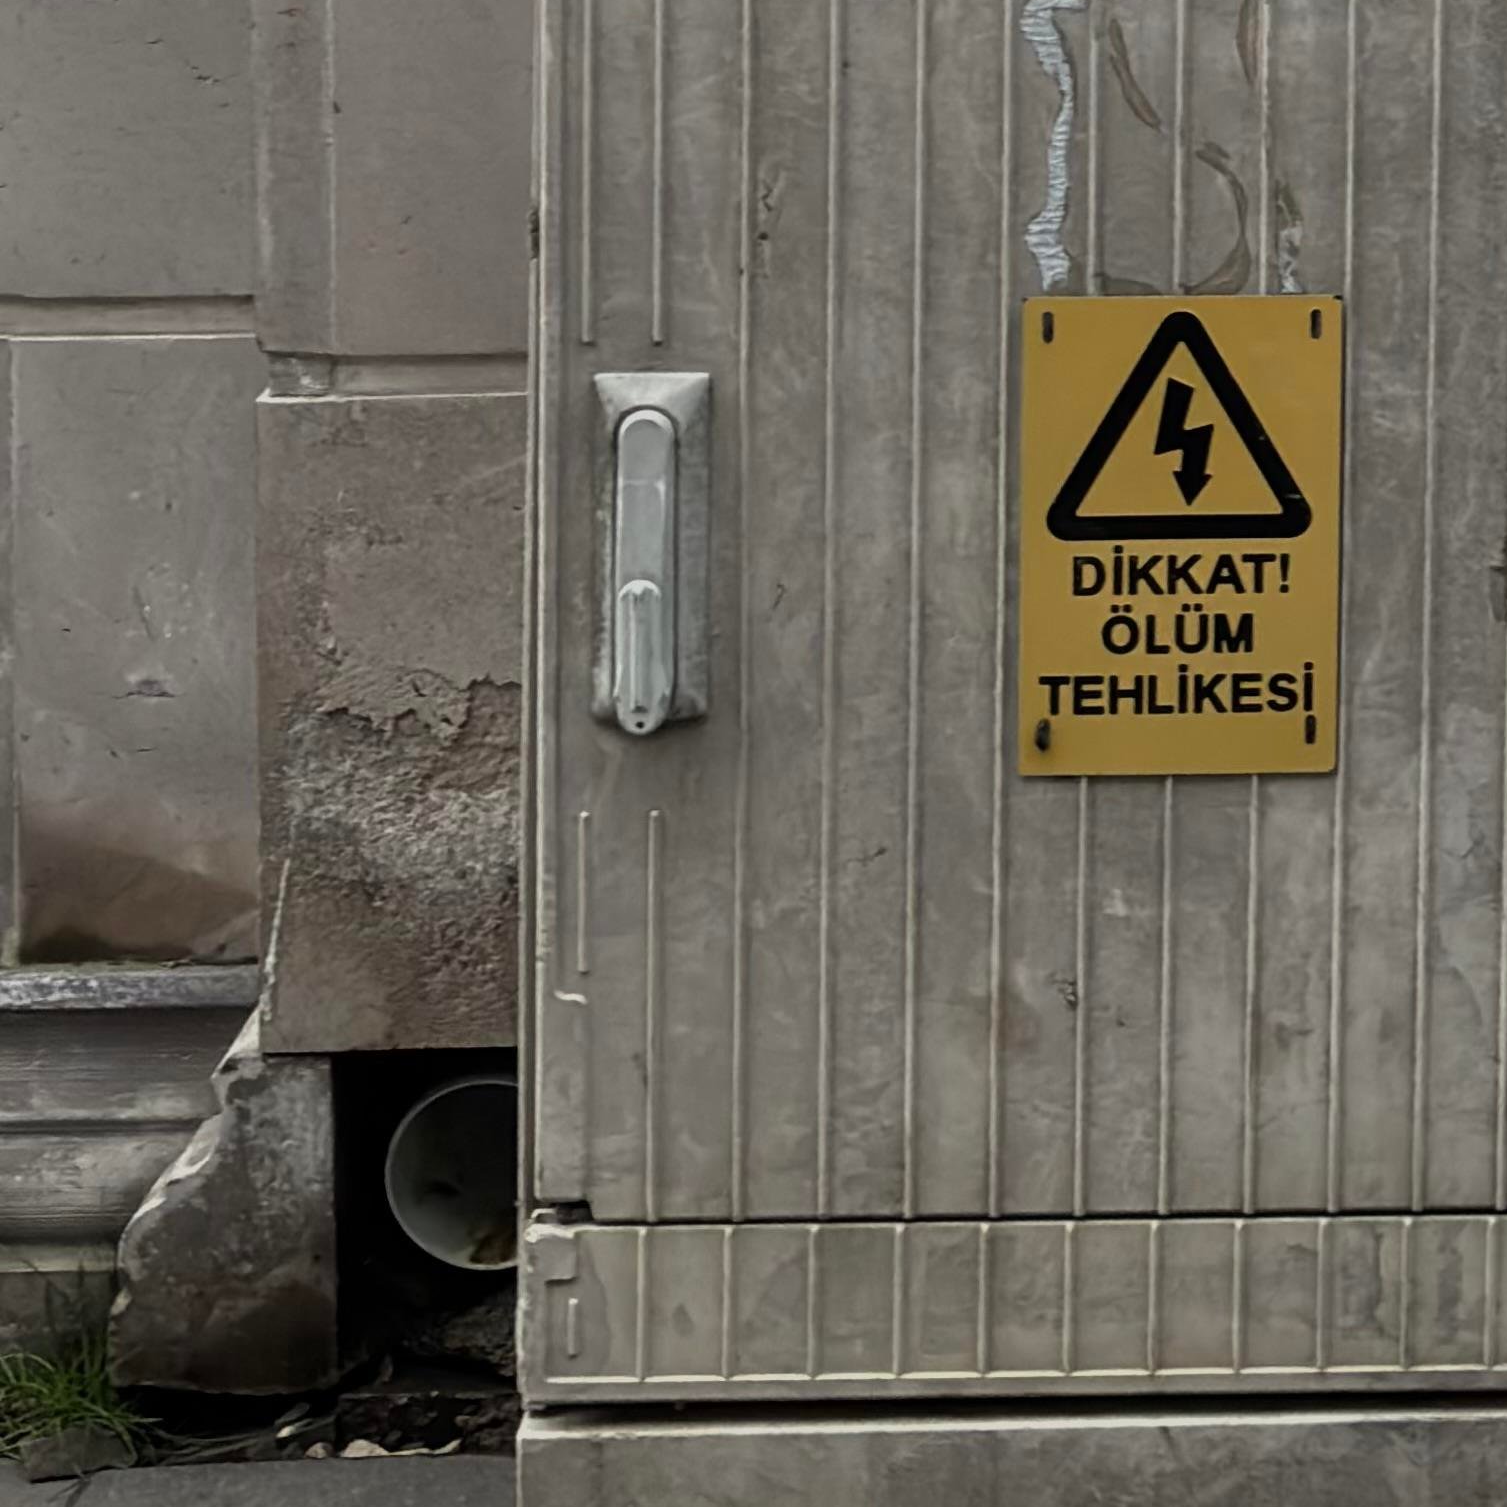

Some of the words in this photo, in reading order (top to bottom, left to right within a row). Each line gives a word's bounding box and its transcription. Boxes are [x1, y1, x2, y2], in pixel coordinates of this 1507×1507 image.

[1071, 545, 1291, 596] DİKKAT!
[1101, 603, 1255, 655] ÖLÜM
[1038, 661, 1315, 716] TEHLİKESİ
